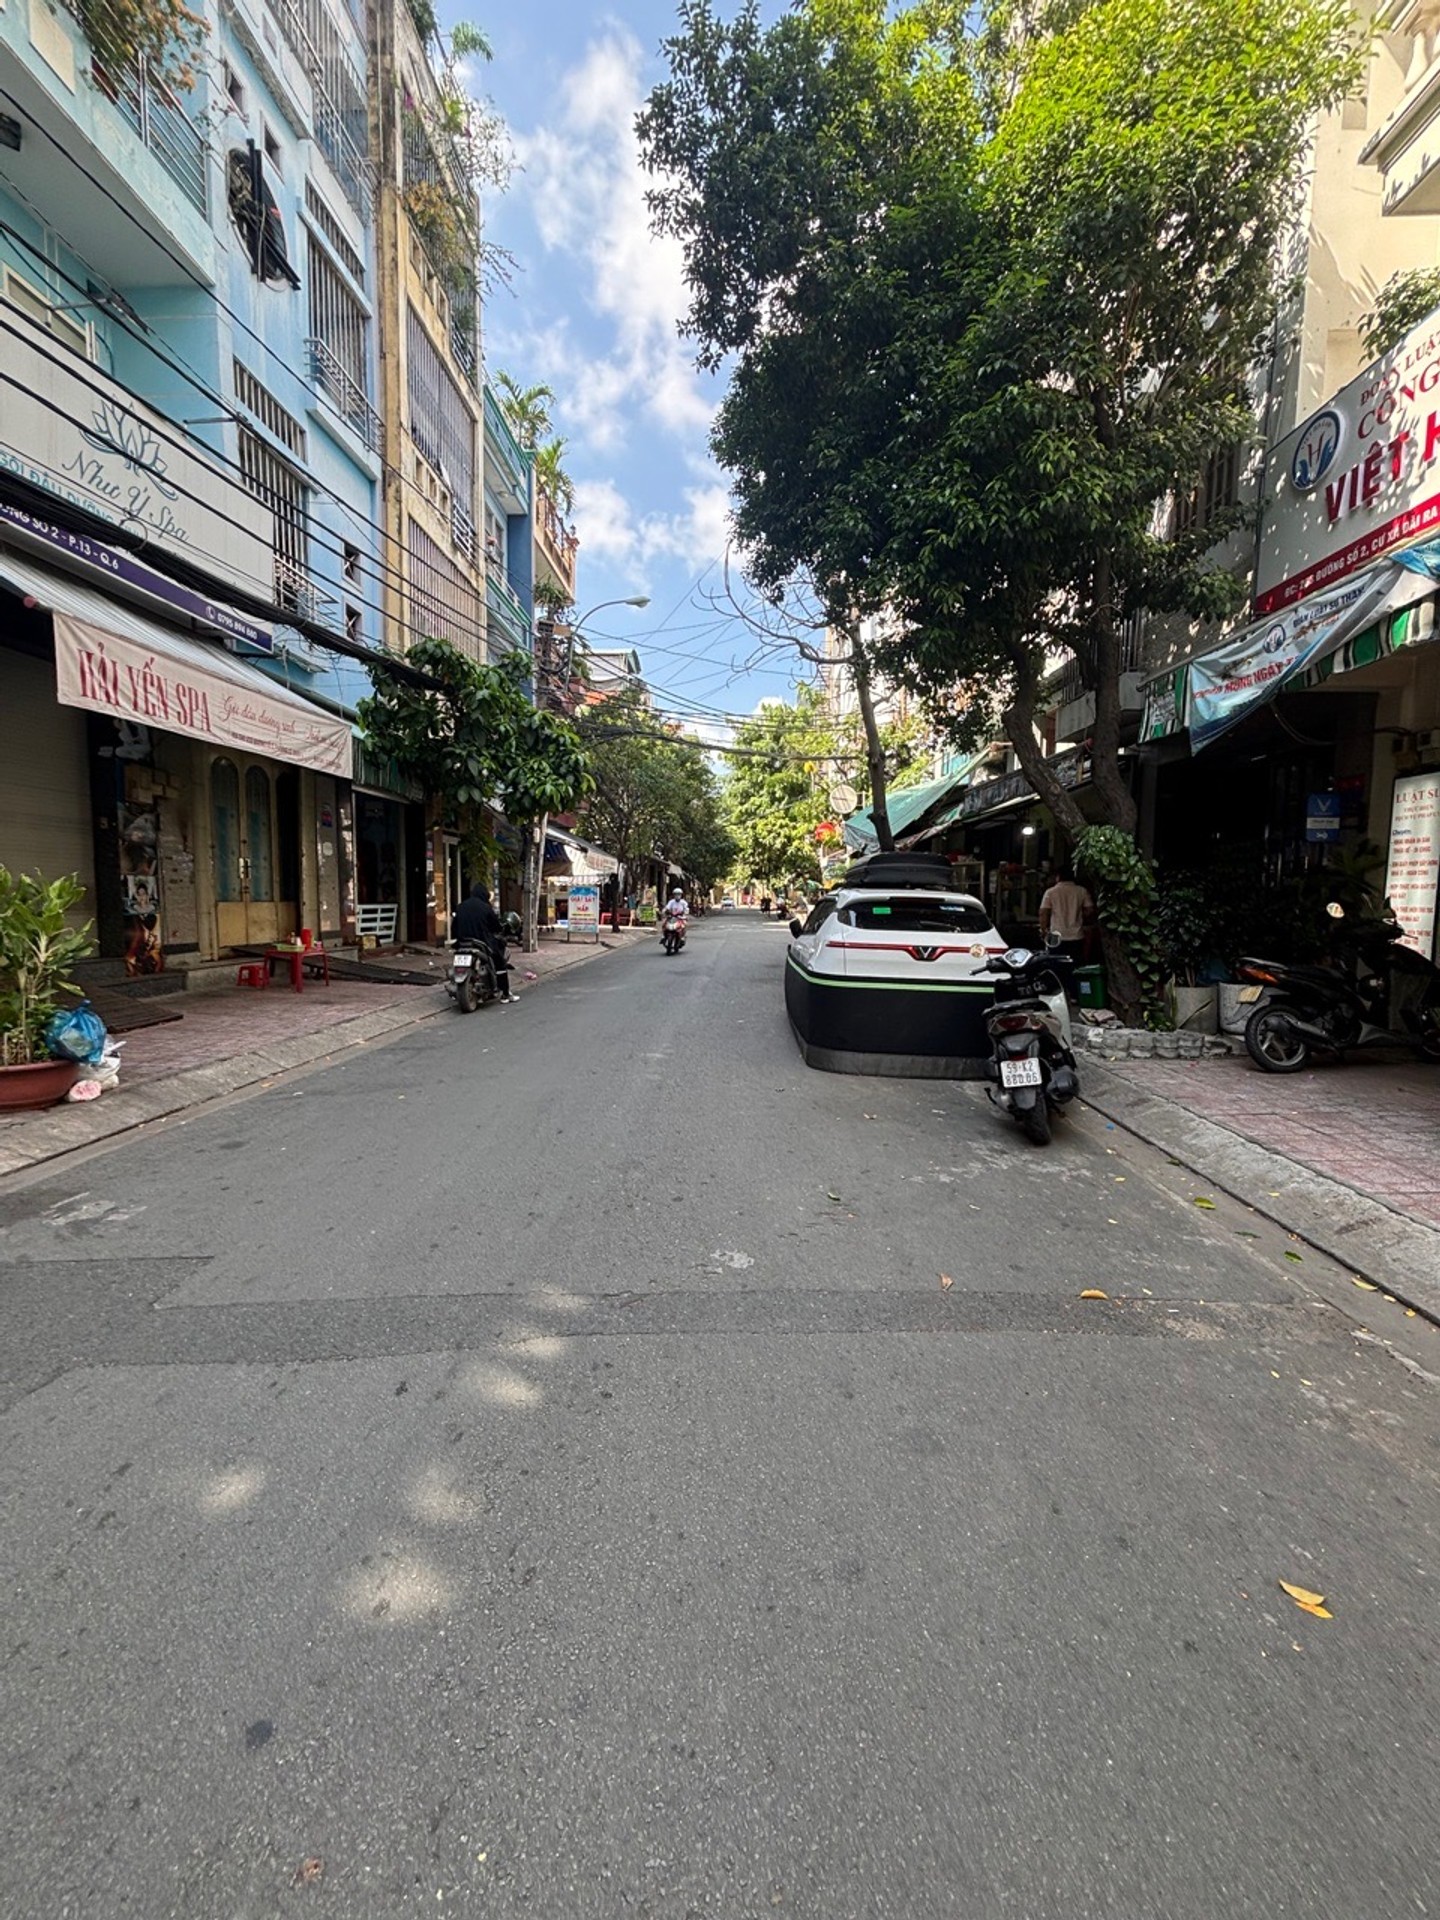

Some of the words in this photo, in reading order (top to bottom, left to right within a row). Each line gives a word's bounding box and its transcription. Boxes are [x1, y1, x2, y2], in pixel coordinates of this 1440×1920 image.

[1357, 360, 1440, 439] CÔNG
[61, 451, 122, 500] Như
[149, 505, 190, 541] Spa
[1325, 431, 1410, 522] VIỆT
[1423, 505, 1438, 523] RA
[51, 527, 60, 540] 2
[68, 535, 92, 556] P.13
[100, 552, 119, 570] Q.6
[77, 642, 122, 708] HẢI
[126, 657, 169, 720] YẾN
[175, 682, 212, 733] SPA
[1396, 789, 1424, 804] LUẬT
